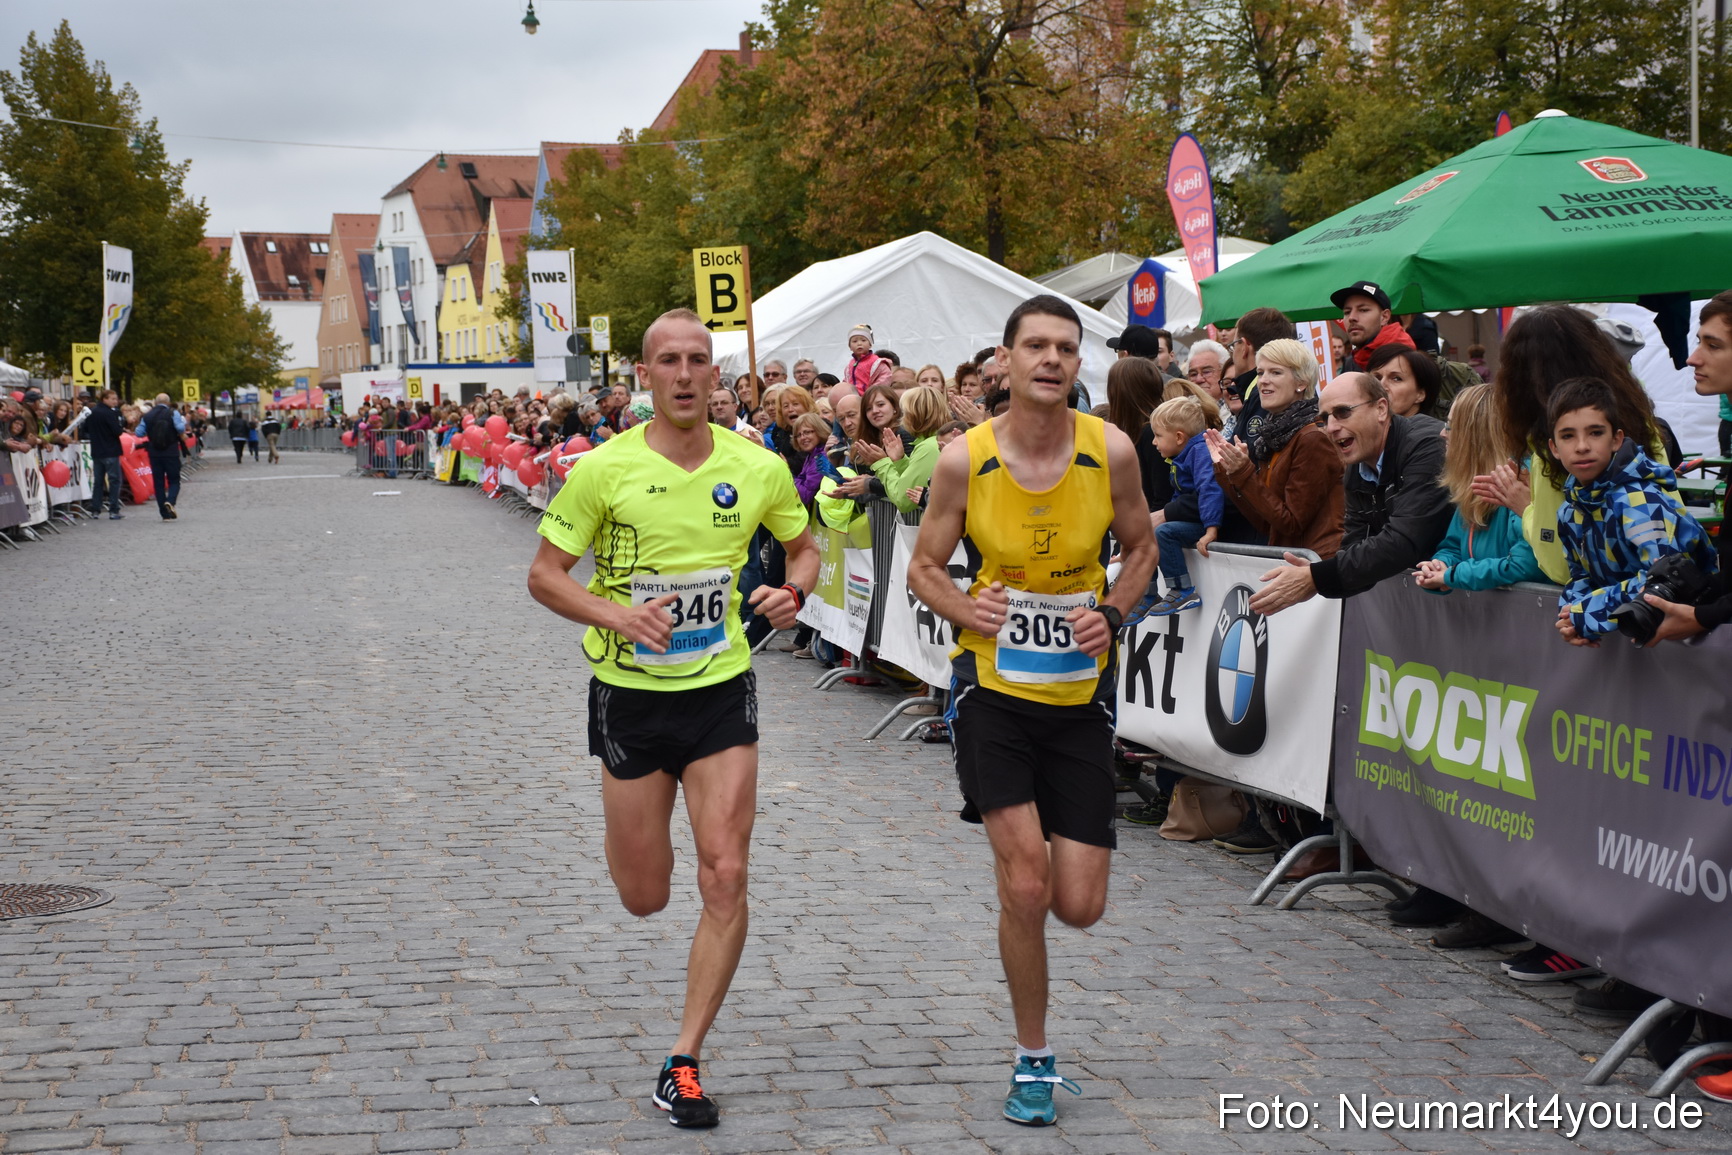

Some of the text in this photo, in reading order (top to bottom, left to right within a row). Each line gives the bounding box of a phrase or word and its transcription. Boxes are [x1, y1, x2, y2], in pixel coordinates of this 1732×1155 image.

[1559, 185, 1717, 205] Neumarkter
[1562, 225, 1593, 233] DAS
[1597, 221, 1640, 230] FEINE
[700, 250, 743, 267] Block
[709, 273, 738, 314] B
[75, 345, 99, 354] Block
[80, 356, 95, 377] C
[187, 386, 196, 397] D
[410, 383, 419, 394] D
[554, 514, 574, 532] Partl
[712, 512, 740, 523] Partl
[1001, 568, 1026, 580] Seidl
[634, 579, 718, 593] PARTL Neumarkt
[643, 589, 724, 628] 346
[1008, 599, 1036, 609] ARTL
[671, 634, 708, 651] lorian
[1362, 659, 1531, 786] BOCK
[1551, 709, 1653, 786] OFFICE
[1355, 751, 1411, 793] inspired
[1460, 798, 1536, 842] concepts
[1597, 826, 1732, 904] www.bo
